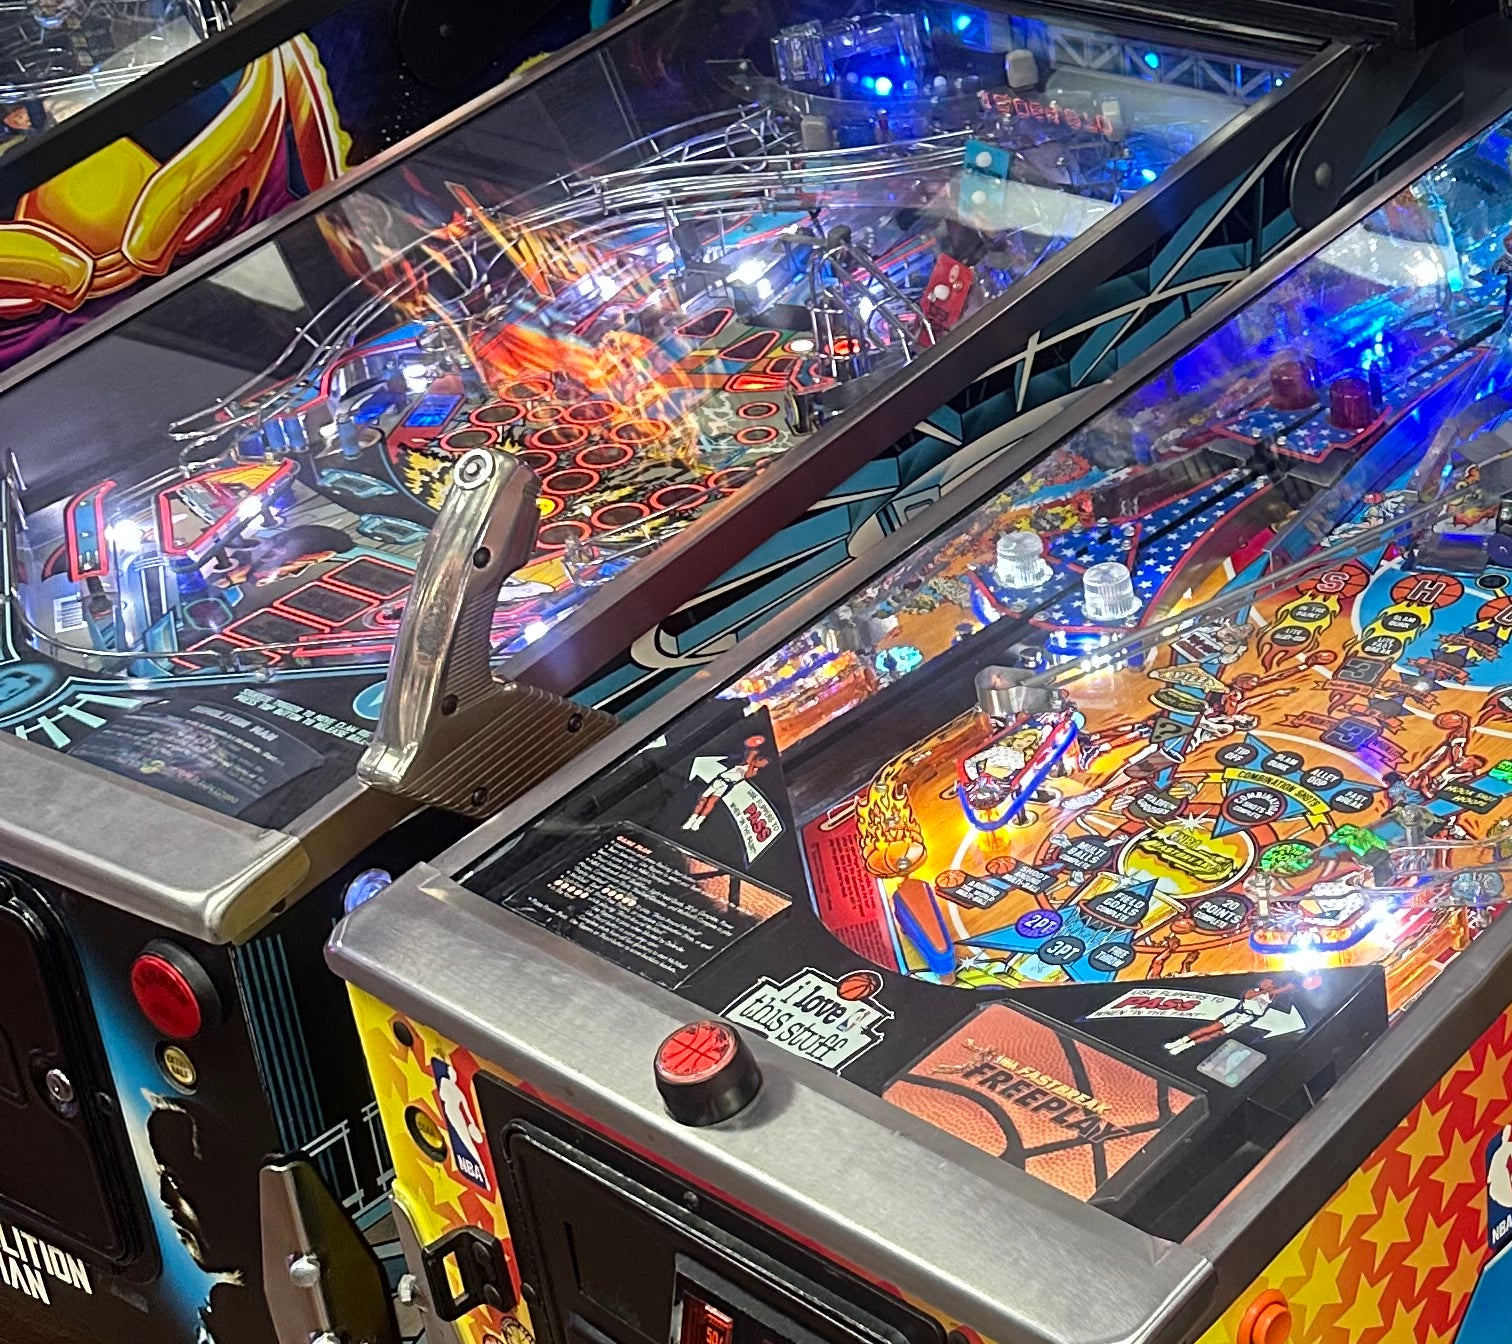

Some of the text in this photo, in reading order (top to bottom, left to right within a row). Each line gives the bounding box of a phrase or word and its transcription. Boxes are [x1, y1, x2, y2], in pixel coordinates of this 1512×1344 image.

[1315, 571, 1350, 593] S
[1406, 578, 1447, 605] H
[1266, 759, 1291, 771] DUNK
[1274, 753, 1299, 766] SLAM
[1311, 768, 1341, 783] ALLEY
[1237, 769, 1321, 808] COMBINATION SHOTS
[1344, 791, 1368, 804] FAST
[1335, 795, 1362, 810] BREAK
[742, 801, 772, 843] PASS
[1066, 847, 1101, 864] BALLS
[1078, 840, 1108, 858] MULTI
[1019, 866, 1050, 881] SHOOT
[1102, 898, 1139, 916] GOALS
[1113, 891, 1146, 909] FIELD
[1221, 899, 1240, 911] 20
[1194, 910, 1229, 929] COMPLETE
[1199, 901, 1243, 924] POINTS
[1024, 914, 1056, 933] 2PT
[1046, 940, 1080, 958] 3PT
[793, 985, 848, 1025] love
[1110, 996, 1202, 1012] PASS
[739, 993, 849, 1062] this stuff
[1016, 1066, 1113, 1114] FASTBREAK
[961, 1062, 1130, 1144] FREEPLAY
[458, 1154, 485, 1183] NBA
[0, 1224, 93, 1295] LITION
[0, 1252, 51, 1305] AN
